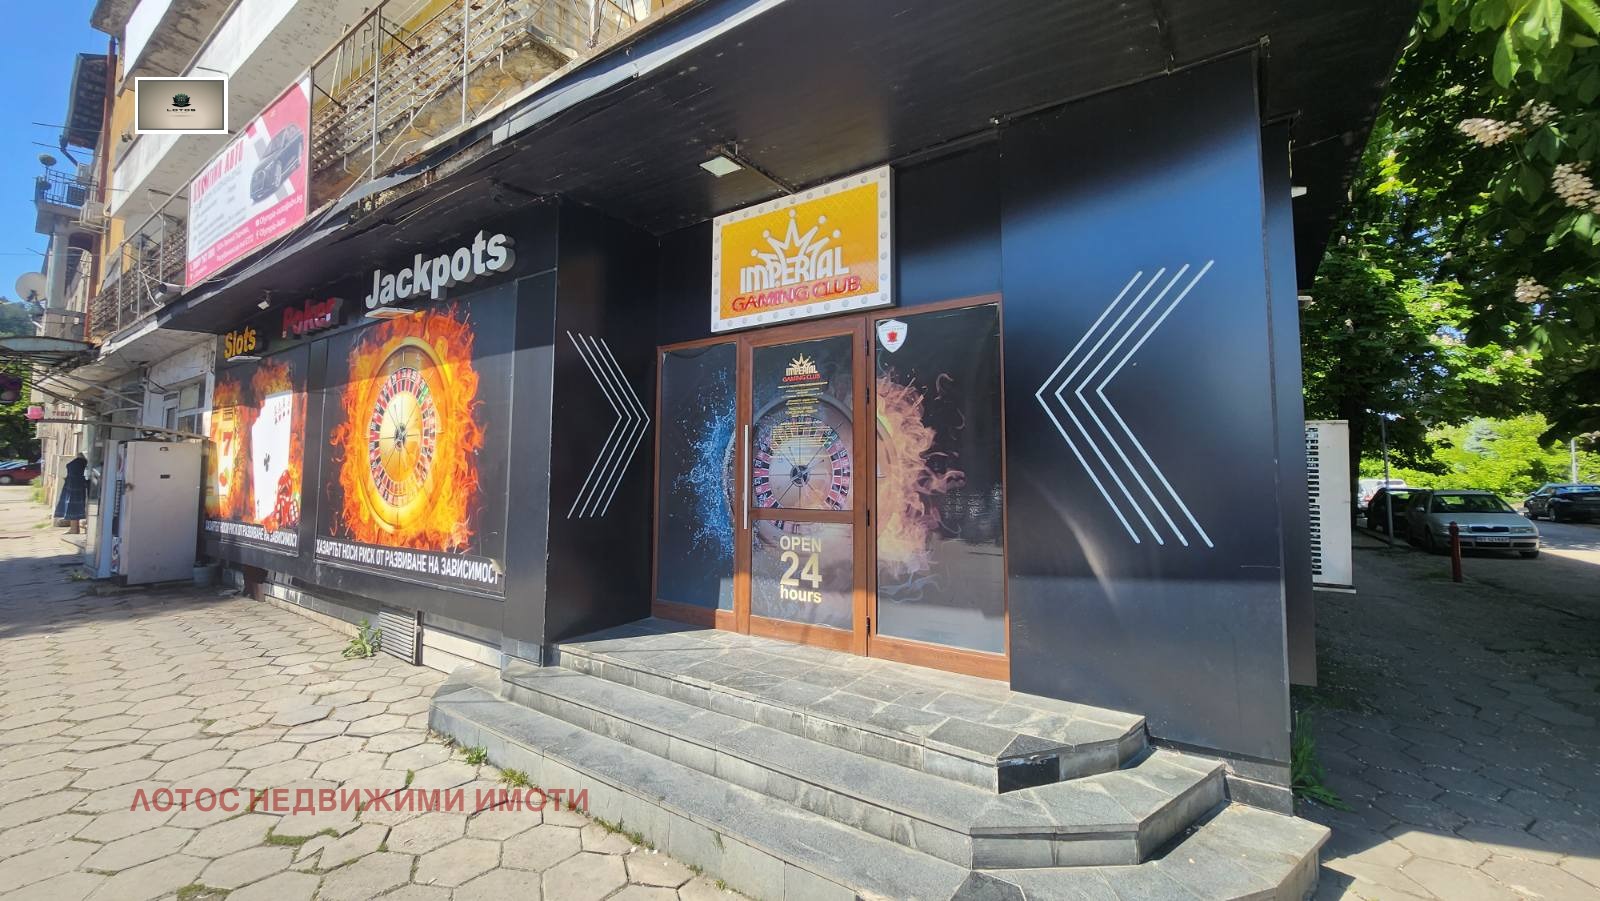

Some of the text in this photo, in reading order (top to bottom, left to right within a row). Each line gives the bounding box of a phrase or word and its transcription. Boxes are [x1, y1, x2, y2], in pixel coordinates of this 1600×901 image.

[365, 229, 508, 309] Jackpots
[740, 246, 850, 294] IMPERIAL
[732, 275, 862, 312] GAMING CLUB
[282, 297, 337, 338] Poker
[224, 326, 256, 359] Slots
[785, 363, 819, 377] IMPERIAL
[316, 539, 499, 585] ХАЗАРТЪТ НОСИ РИСК ОТ РАЗВИВАНЕ НА ЗАВИСИМОСТ
[780, 536, 822, 552] OPEN
[780, 551, 822, 588] 24
[780, 584, 822, 603] hours
